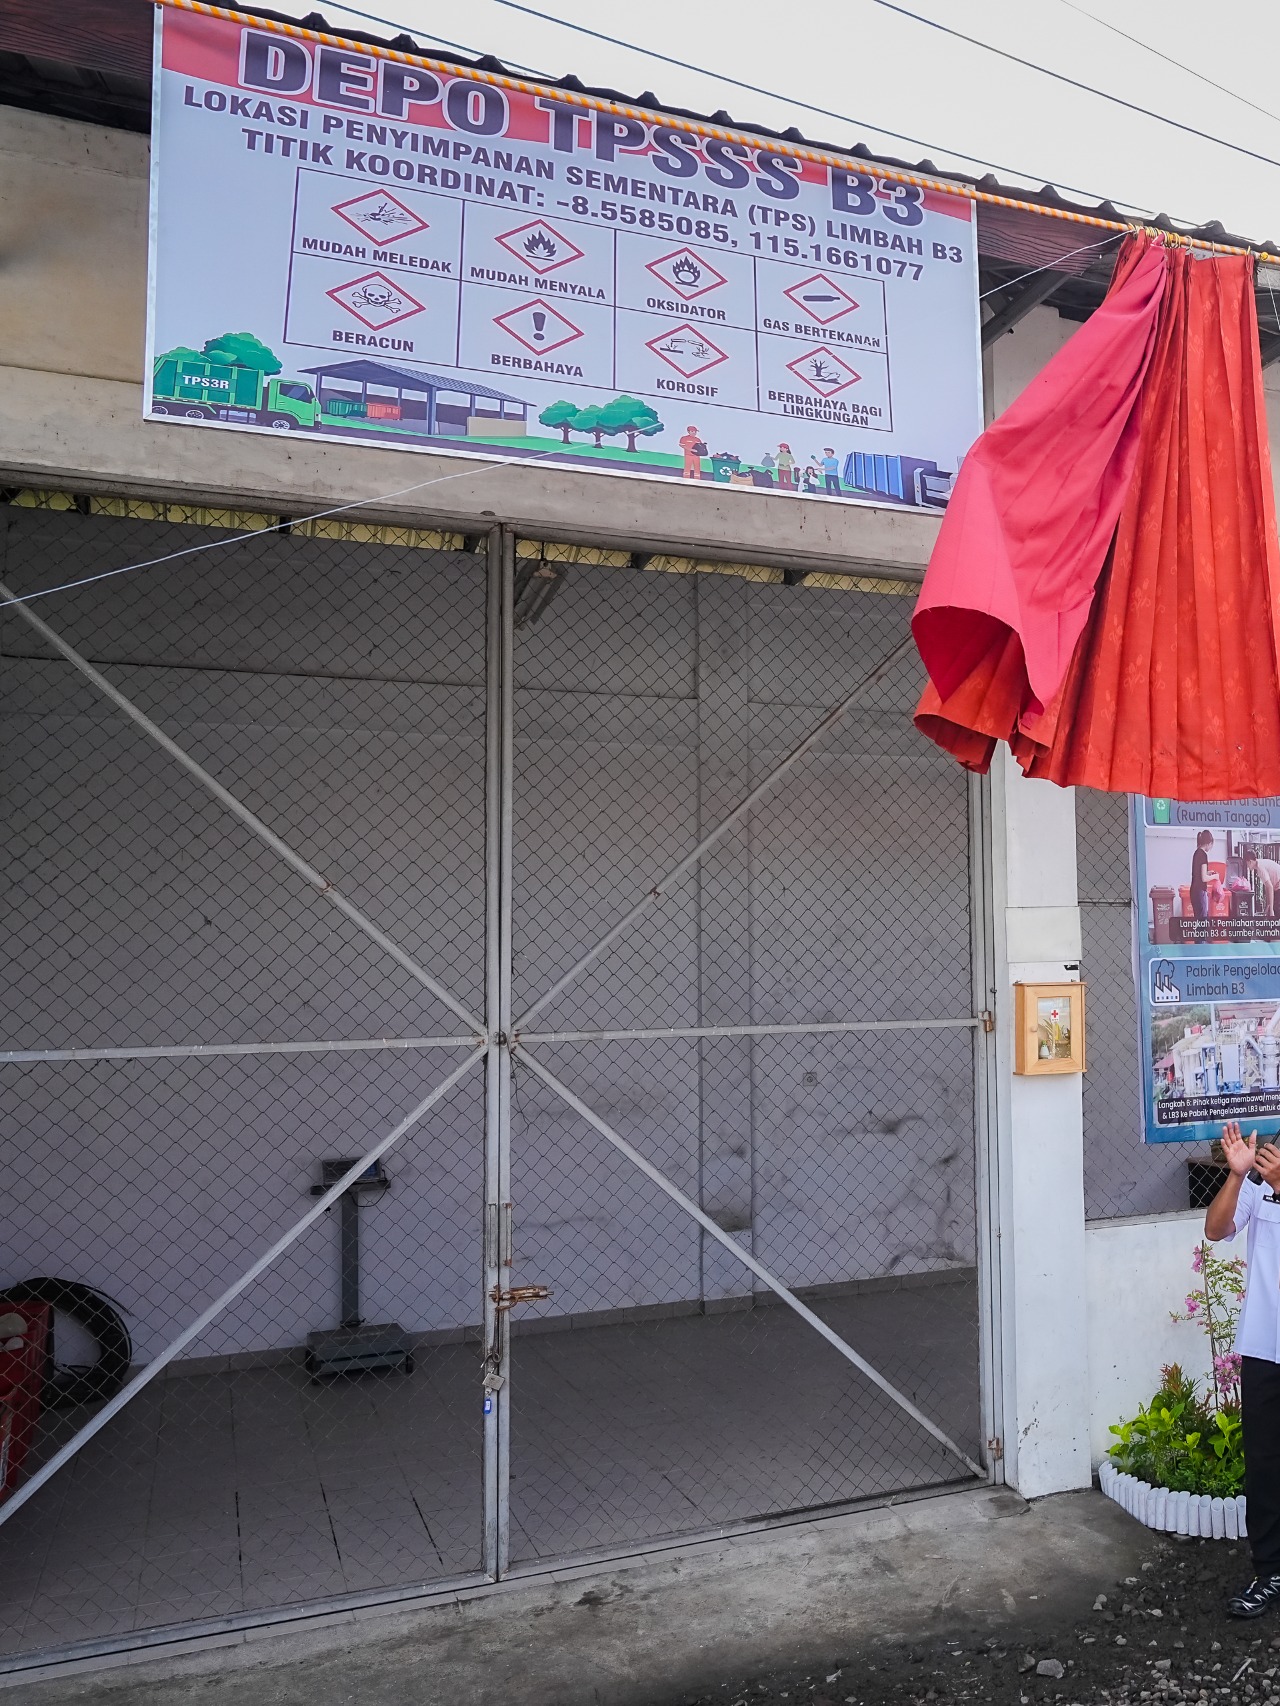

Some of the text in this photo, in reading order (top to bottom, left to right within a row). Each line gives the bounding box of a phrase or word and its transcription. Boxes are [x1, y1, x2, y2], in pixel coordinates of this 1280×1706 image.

[239, 28, 925, 227] DEPO TPSSS B3
[183, 86, 963, 264] LOKASI PENYIMPANAN SEMENTARA (TPS) LIMBAH B3
[242, 127, 925, 281] TITIK KOORDINAT: -8.5585085, 115.1661077
[302, 236, 453, 274] MUDAH MELEDAK
[470, 266, 606, 300] MUDAH MENYALA
[646, 297, 727, 321] OKSIDATOR
[332, 330, 415, 353] BERACUN
[763, 318, 881, 348] GAS BERTEKANAN
[490, 353, 584, 378] BERBAHAYA
[182, 375, 230, 390] TPS3R
[656, 378, 719, 398] KOROSIF
[768, 390, 883, 418] BERBAHAYA BAGI
[783, 403, 869, 427] LINGKUNGAN
[1176, 806, 1271, 826] (Rumah Tangga)
[1180, 919, 1210, 929] Langkah
[1217, 919, 1253, 928] Pemilahan
[1182, 929, 1209, 938] Limbah
[1210, 929, 1219, 938] B3
[1220, 929, 1228, 937] di
[1228, 928, 1254, 937] sumber
[1255, 928, 1280, 937] Rumah
[1186, 964, 1221, 978] Pabrik
[1186, 982, 1245, 996] Limbah B3
[1158, 1100, 1186, 1110] Langkah
[1192, 1098, 1210, 1106] Pihak
[1210, 1097, 1230, 1106] ketiga
[1168, 1111, 1180, 1119] LB3
[1180, 1110, 1188, 1118] ke
[1188, 1109, 1209, 1117] Pabrik
[1209, 1106, 1247, 1116] Pengelolaan
[1247, 1105, 1258, 1113] LB3
[1258, 1104, 1276, 1112] untuk
